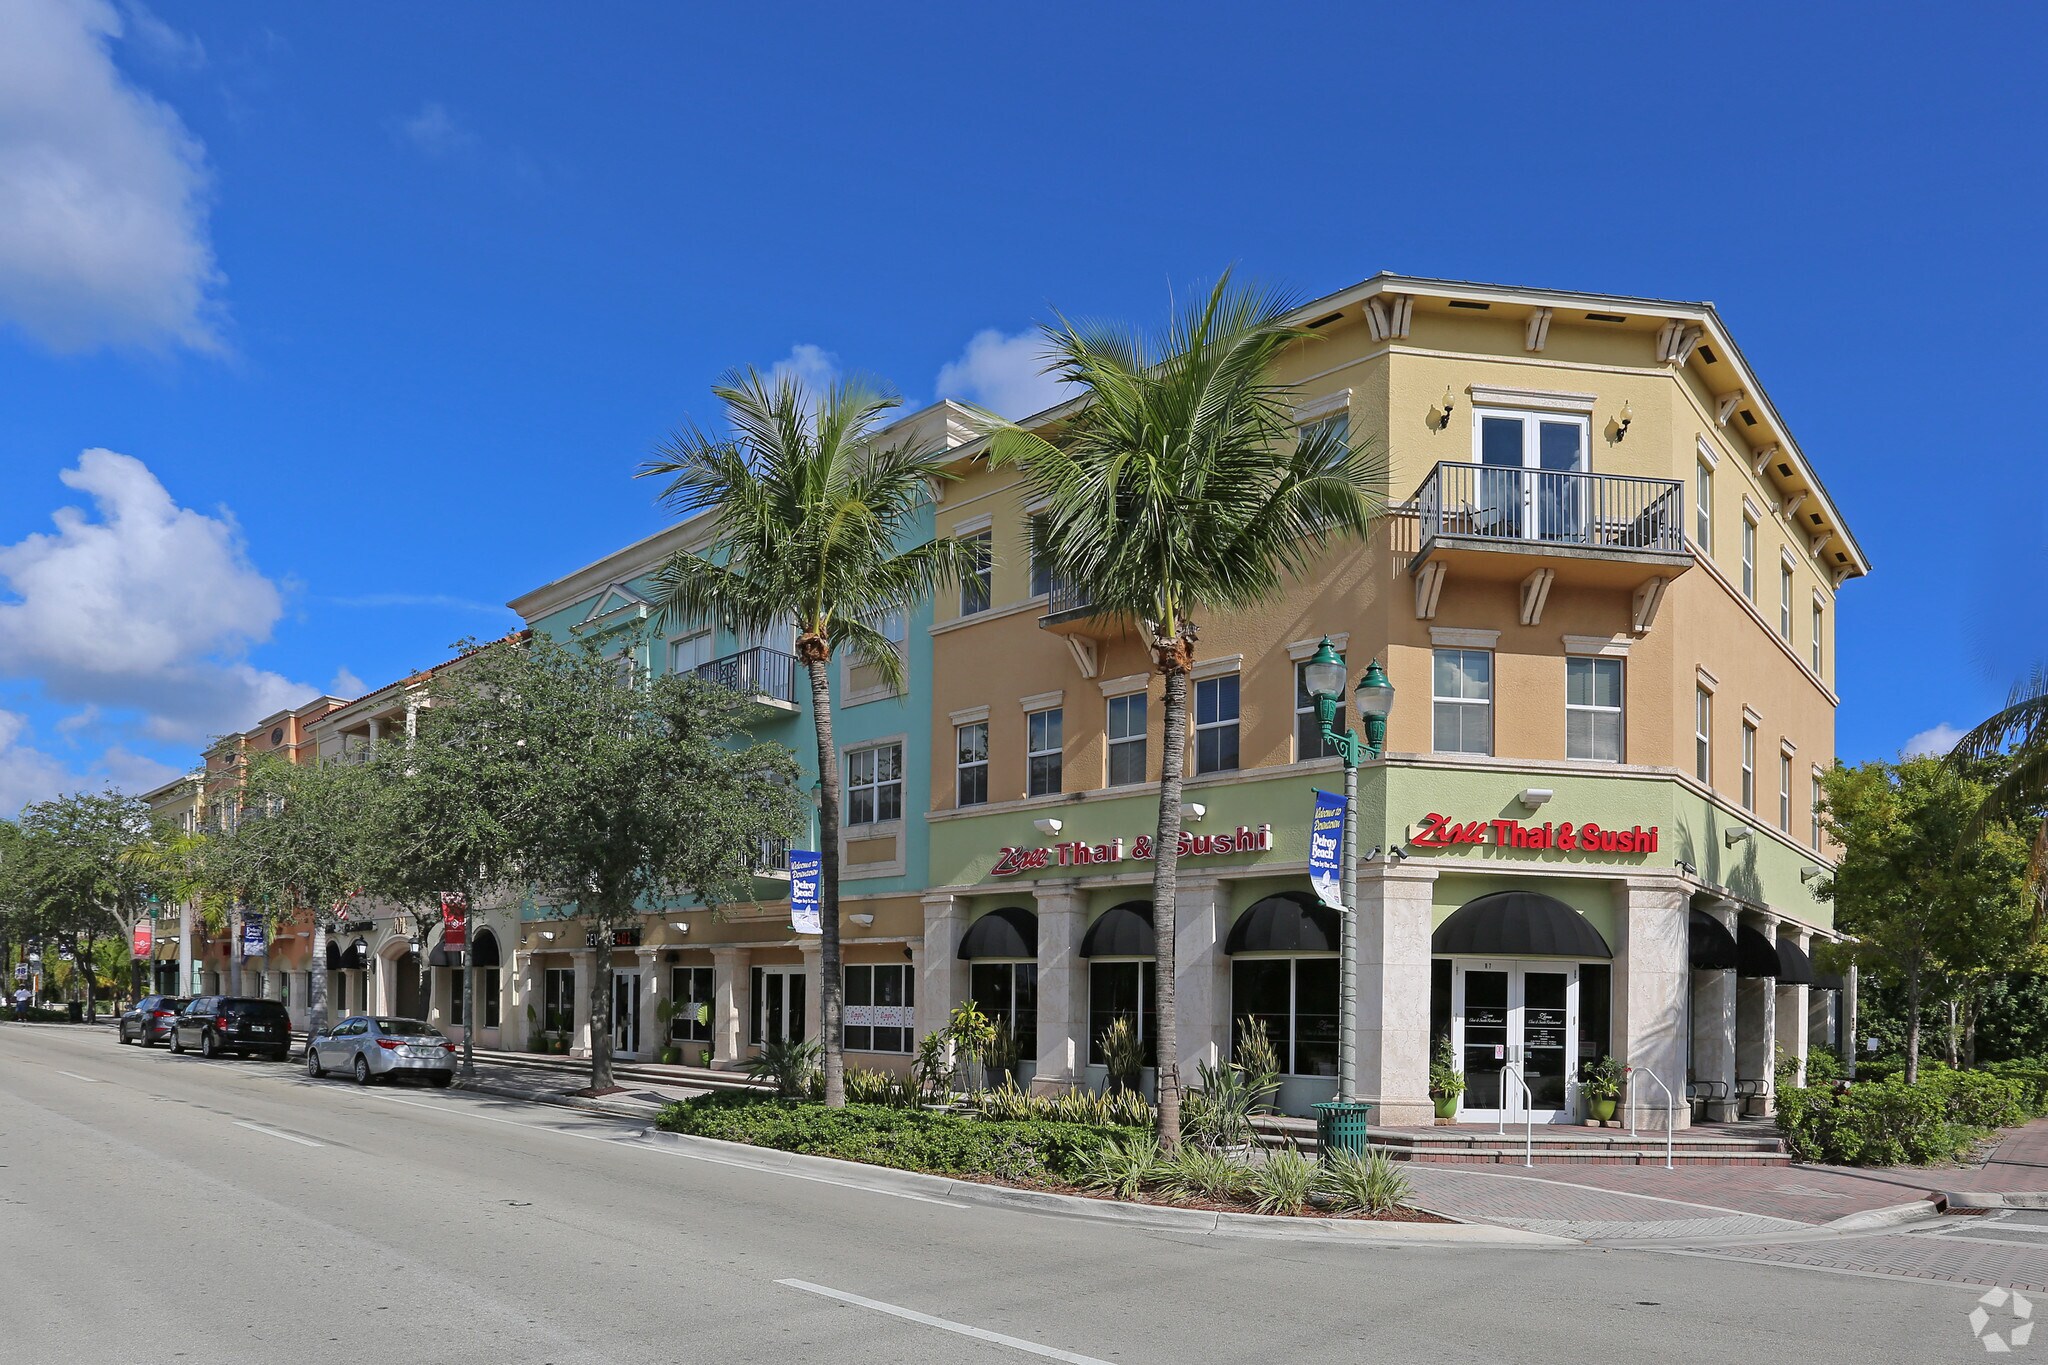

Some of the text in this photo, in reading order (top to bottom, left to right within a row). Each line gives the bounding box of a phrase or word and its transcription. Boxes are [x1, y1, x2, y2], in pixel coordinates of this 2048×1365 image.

[1055, 838, 1122, 867] Thai
[1131, 834, 1156, 860] &
[1176, 823, 1272, 857] Sushi
[1313, 832, 1337, 850] Delray
[1491, 819, 1553, 849] Thai
[1557, 821, 1577, 850] &
[1581, 822, 1658, 853] Sushi
[1312, 845, 1334, 859] Beach
[793, 879, 816, 890] Delray
